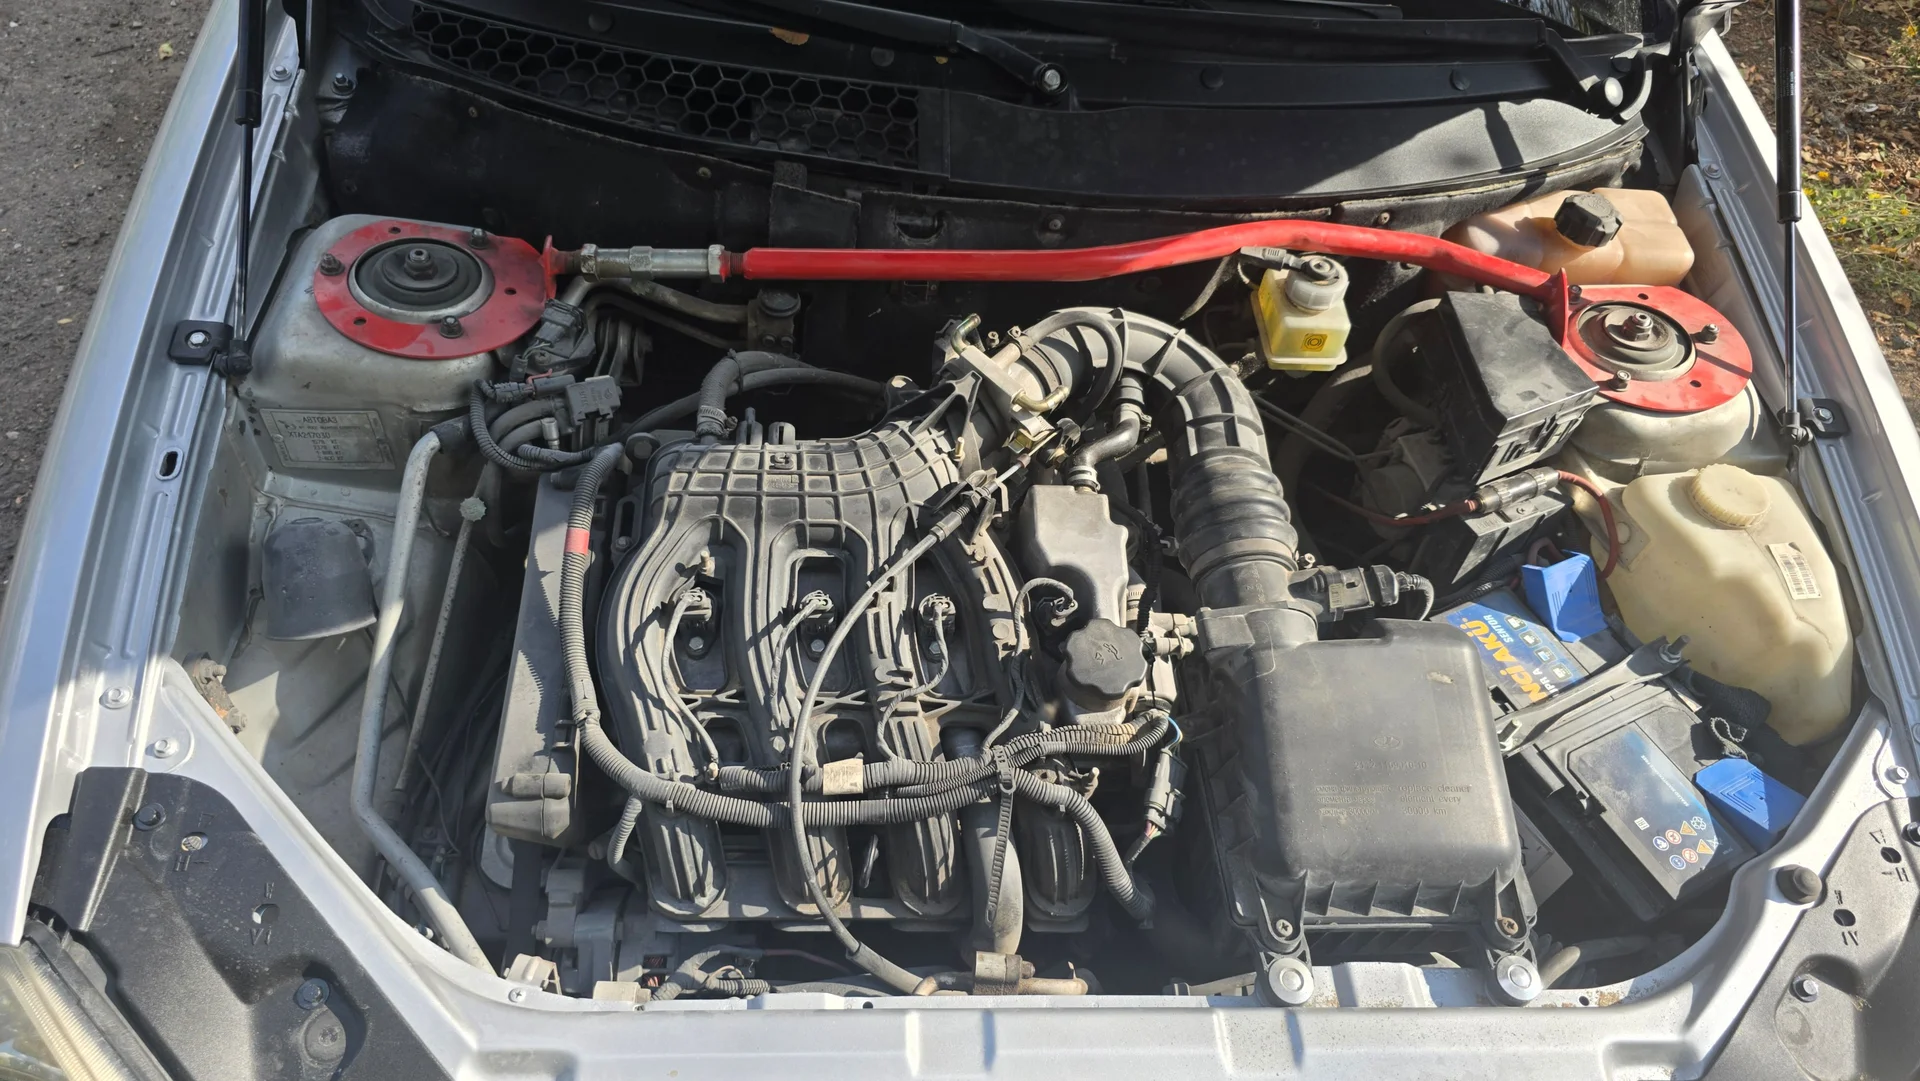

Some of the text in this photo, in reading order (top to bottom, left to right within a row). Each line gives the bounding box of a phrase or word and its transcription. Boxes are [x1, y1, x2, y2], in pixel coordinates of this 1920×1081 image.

[1483, 614, 1514, 643] SENTOR
[1399, 784, 1470, 794] replace cleaner
[1401, 794, 1461, 805] element every
[1433, 806, 1447, 815] km
